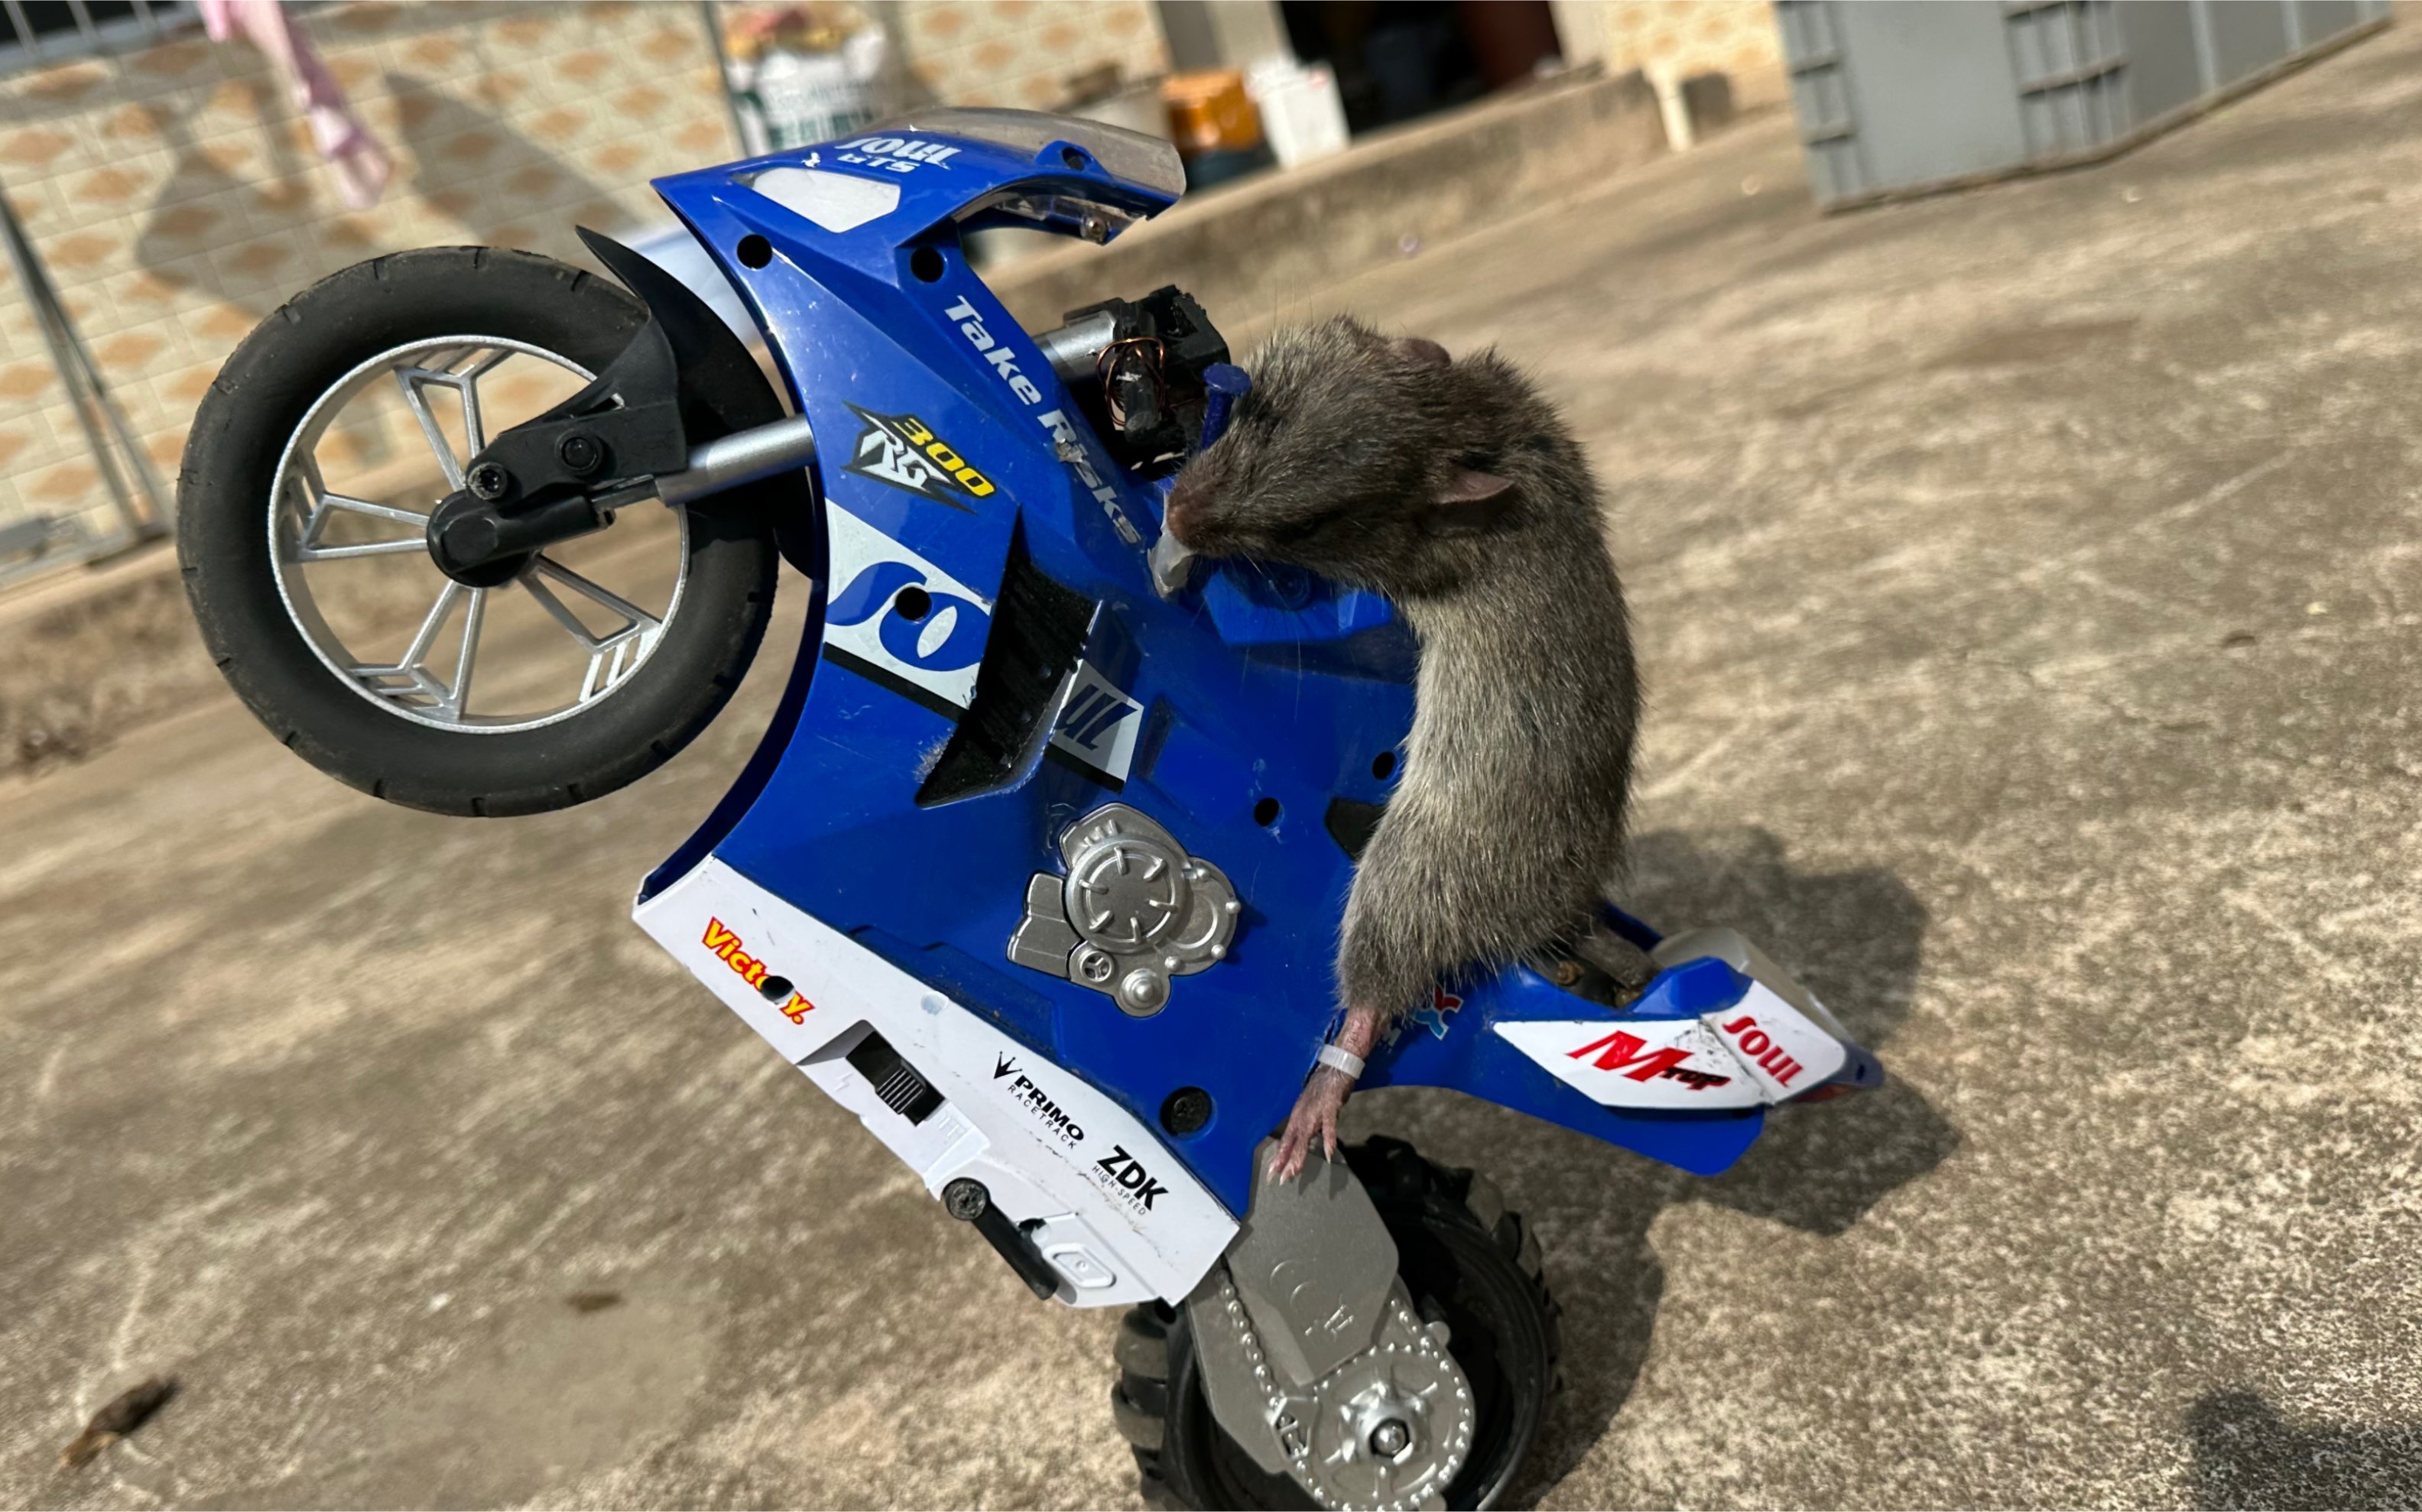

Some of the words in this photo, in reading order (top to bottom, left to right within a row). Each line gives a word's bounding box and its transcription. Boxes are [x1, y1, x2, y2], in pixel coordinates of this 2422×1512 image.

[834, 137, 962, 170] SOUL
[943, 295, 1041, 406] Take
[891, 417, 995, 497] 300
[1723, 1016, 1804, 1088] SOUL
[1007, 1084, 1077, 1150] RACETRACK
[1014, 1074, 1084, 1141] PRIMO
[1091, 1165, 1147, 1215] HIGH-SPEED
[1096, 1144, 1169, 1212] ZDK
